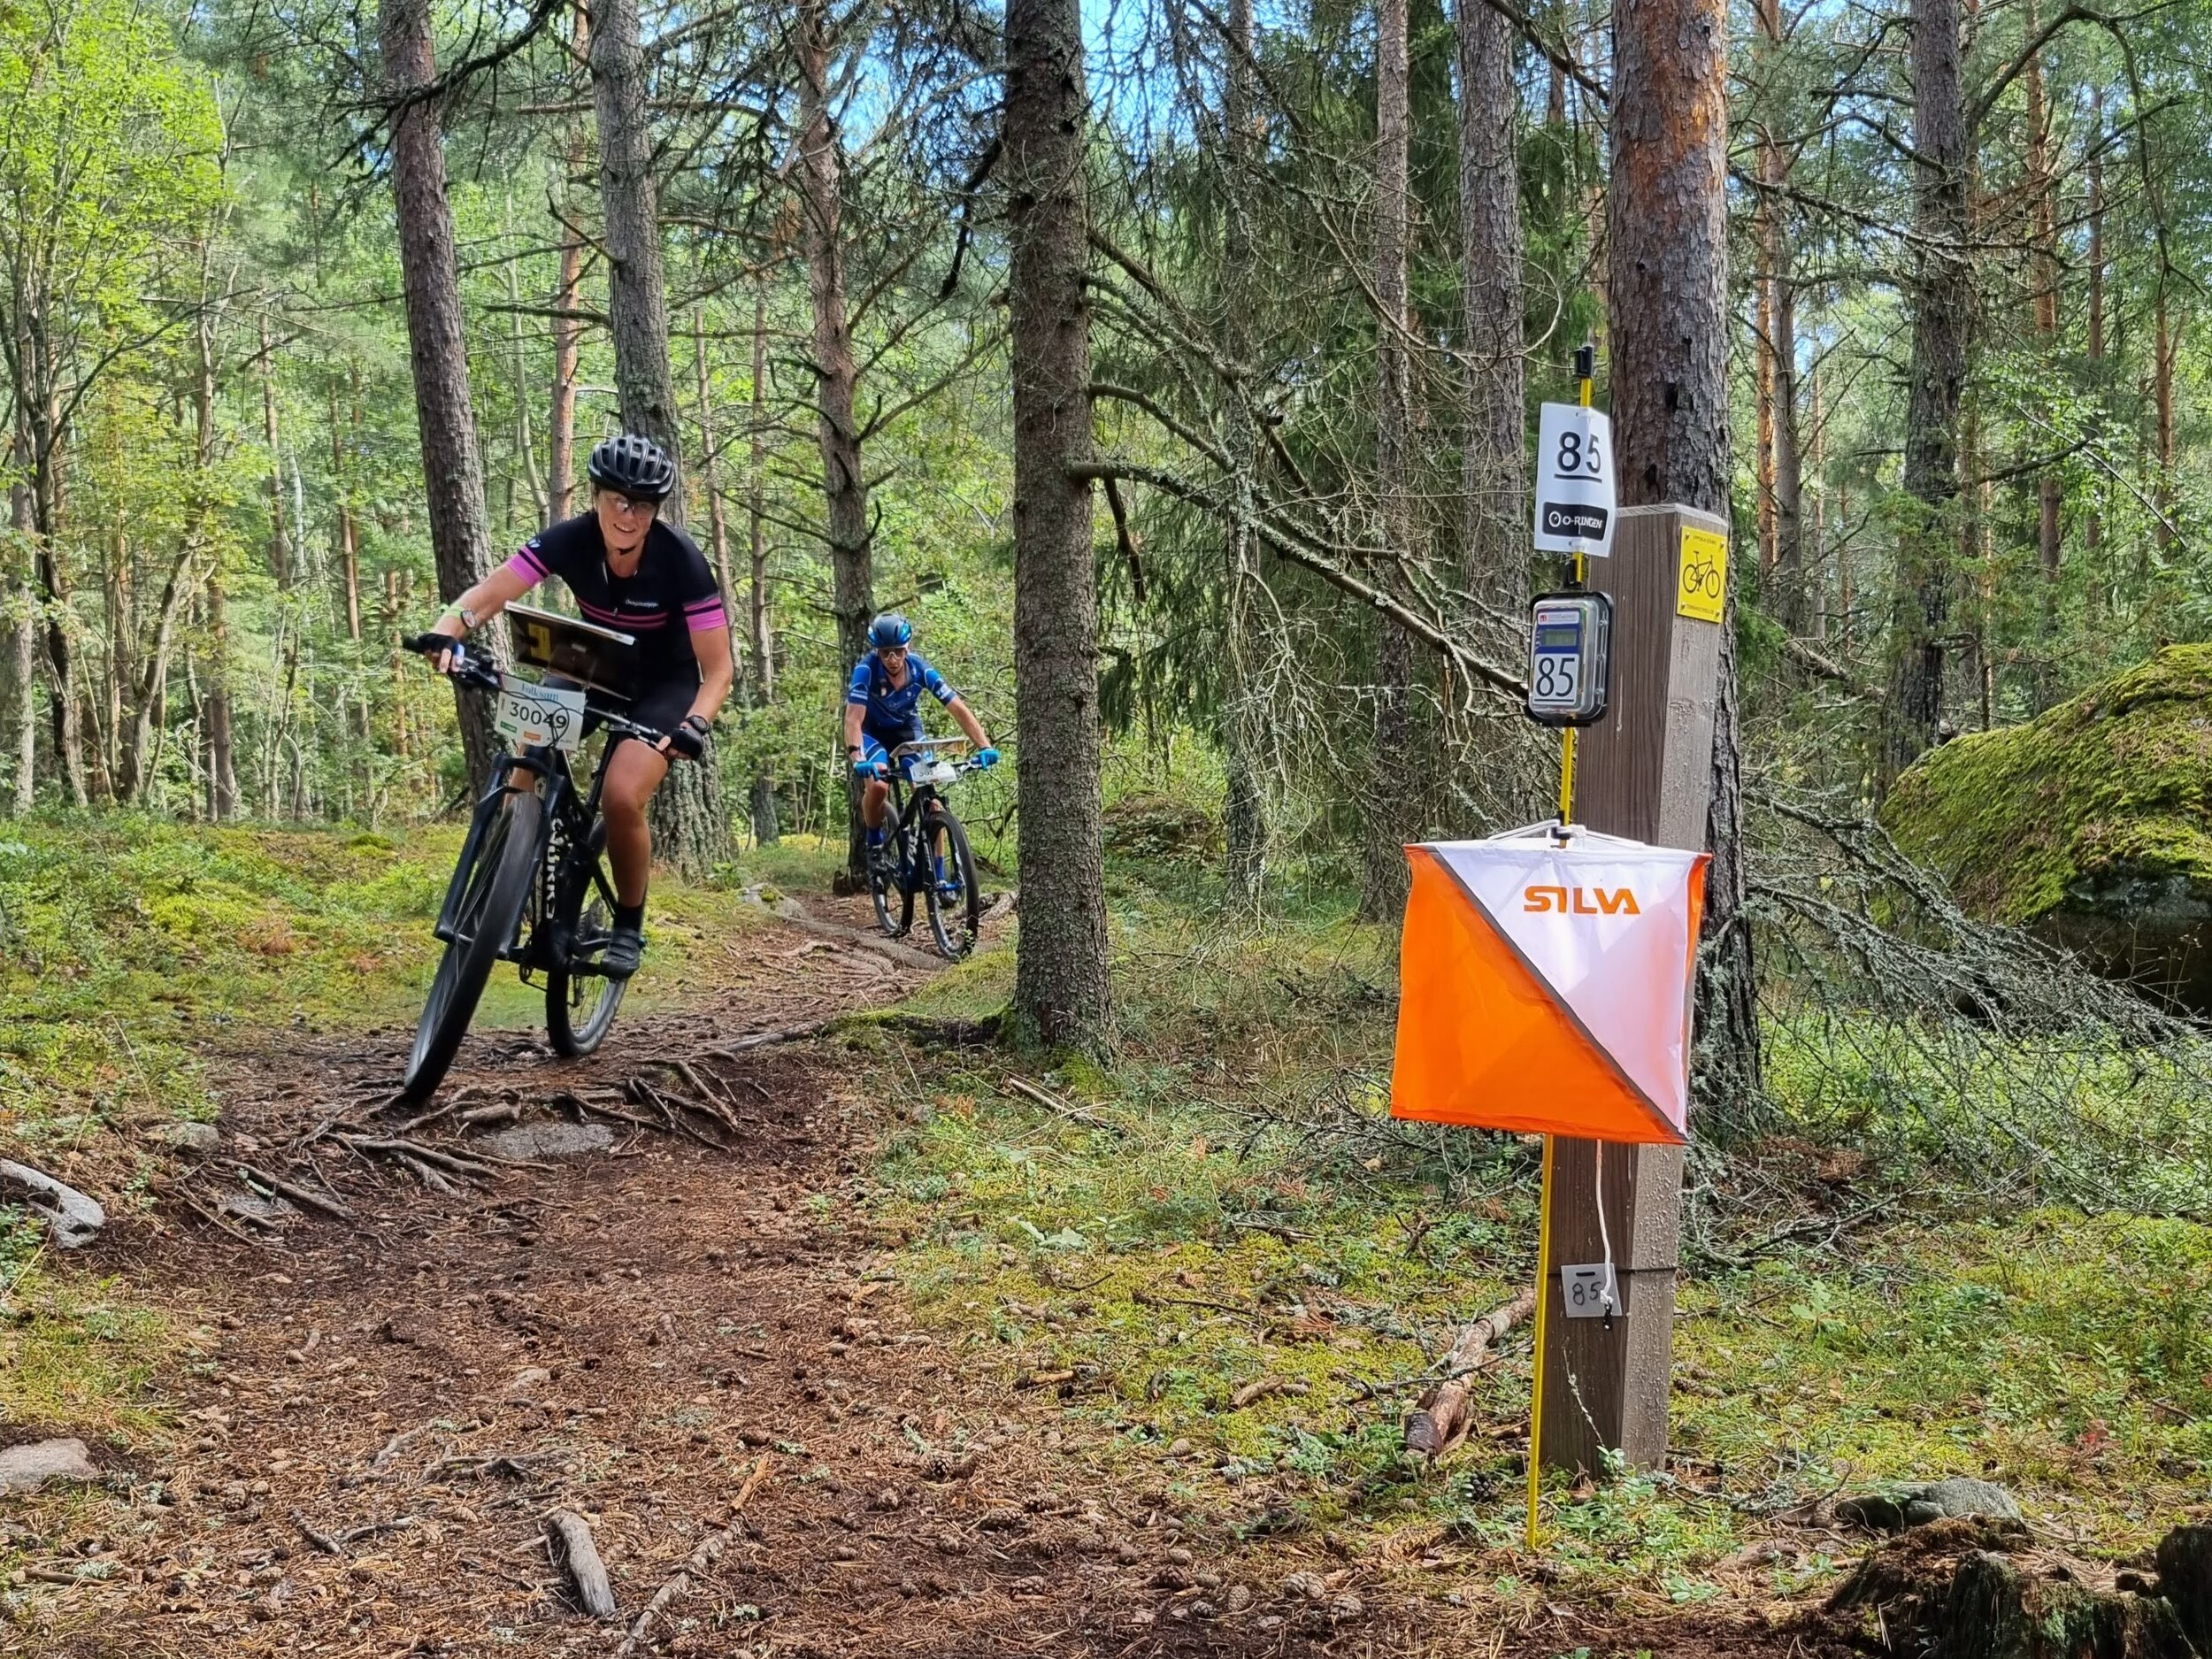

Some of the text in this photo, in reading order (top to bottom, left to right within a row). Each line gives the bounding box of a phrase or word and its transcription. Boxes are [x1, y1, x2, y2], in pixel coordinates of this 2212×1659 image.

[1557, 431, 1601, 474] 85
[1536, 657, 1575, 697] 85
[510, 702, 567, 728] 30049
[1524, 886, 1640, 915] SILVA
[1571, 1281, 1601, 1306] 85
